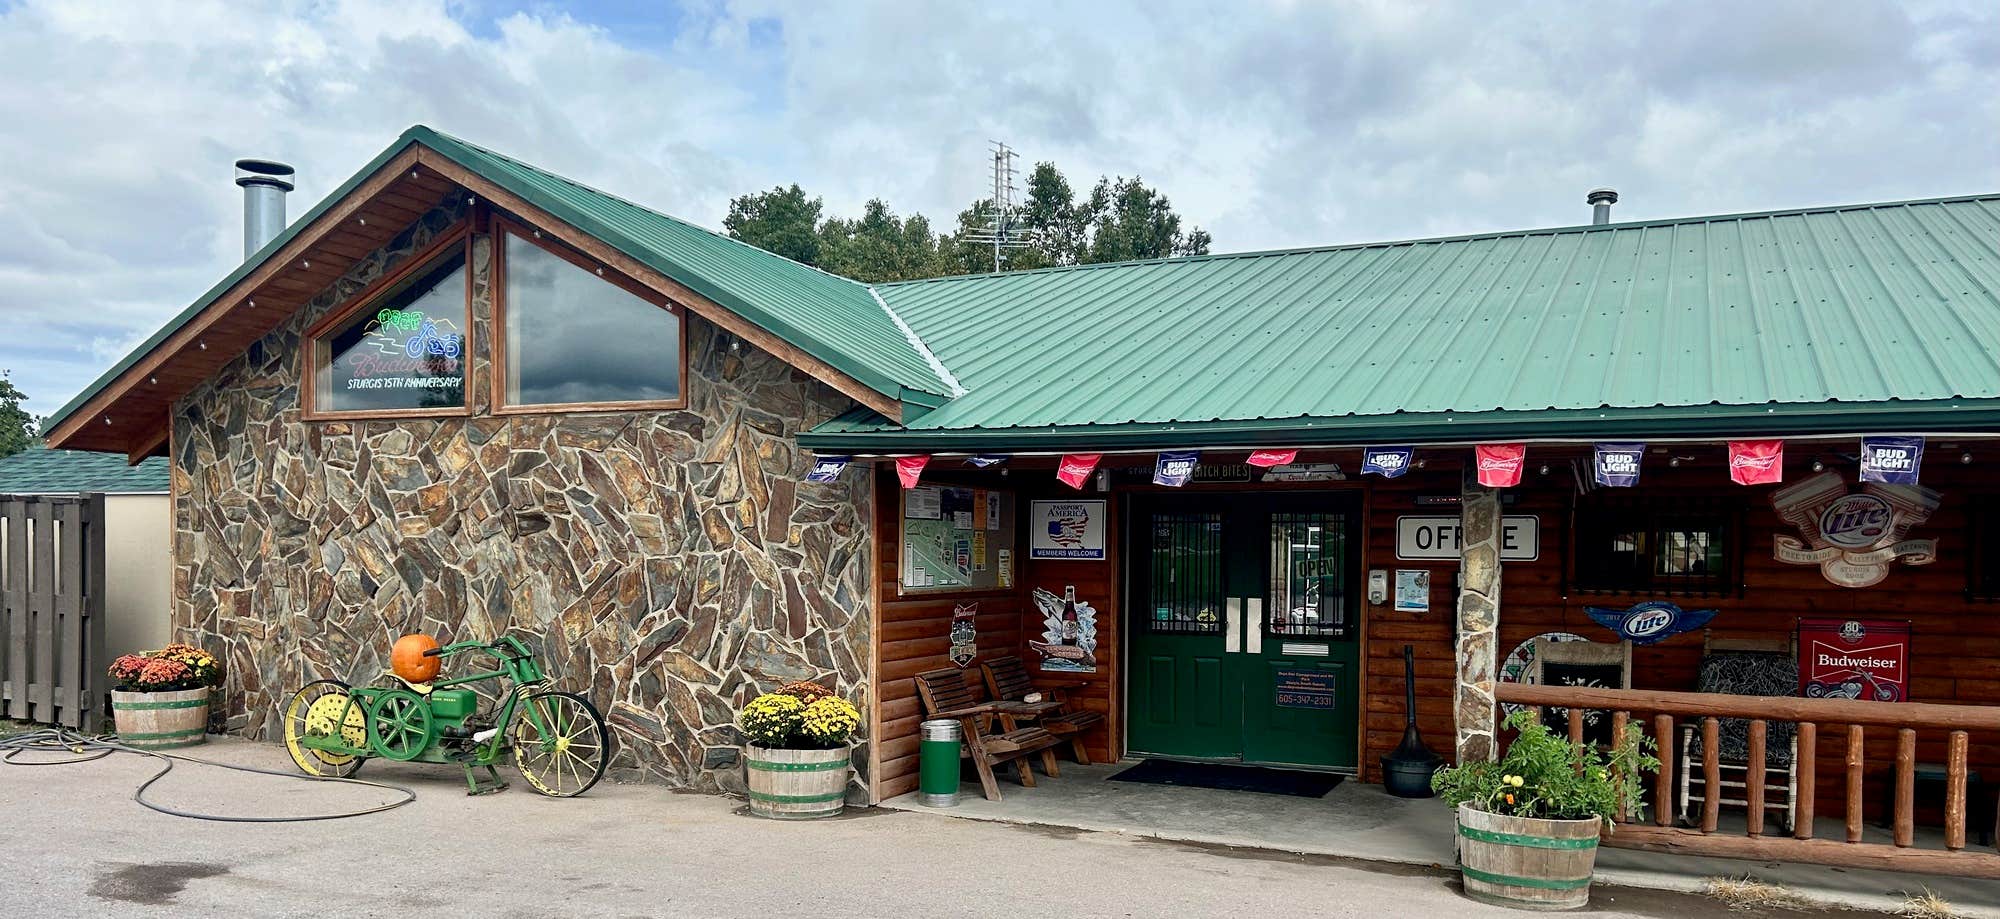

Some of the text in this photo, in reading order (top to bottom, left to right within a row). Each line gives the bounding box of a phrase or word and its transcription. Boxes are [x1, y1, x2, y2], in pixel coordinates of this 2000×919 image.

[348, 379, 382, 389] STURGIS
[404, 376, 462, 388] ANNIVERSARY
[1376, 453, 1401, 461] BUD
[1876, 448, 1907, 458] BUD
[1371, 459, 1404, 468] LIGHT
[1606, 454, 1633, 463] BUD
[1870, 457, 1911, 468] LIGHT
[1482, 459, 1518, 469] Budweiser
[1601, 462, 1638, 472] LIGHT
[1163, 467, 1192, 476] LIGHT
[1048, 507, 1088, 517] AMERICA
[1825, 508, 1890, 534] Lite
[1415, 525, 1518, 550] OFFE
[1299, 558, 1334, 577] OPEN
[1634, 615, 1667, 634] Lite
[1845, 622, 1859, 632] 80
[1818, 654, 1896, 668] Budweiser
[1278, 694, 1332, 705] 605-347-2331
